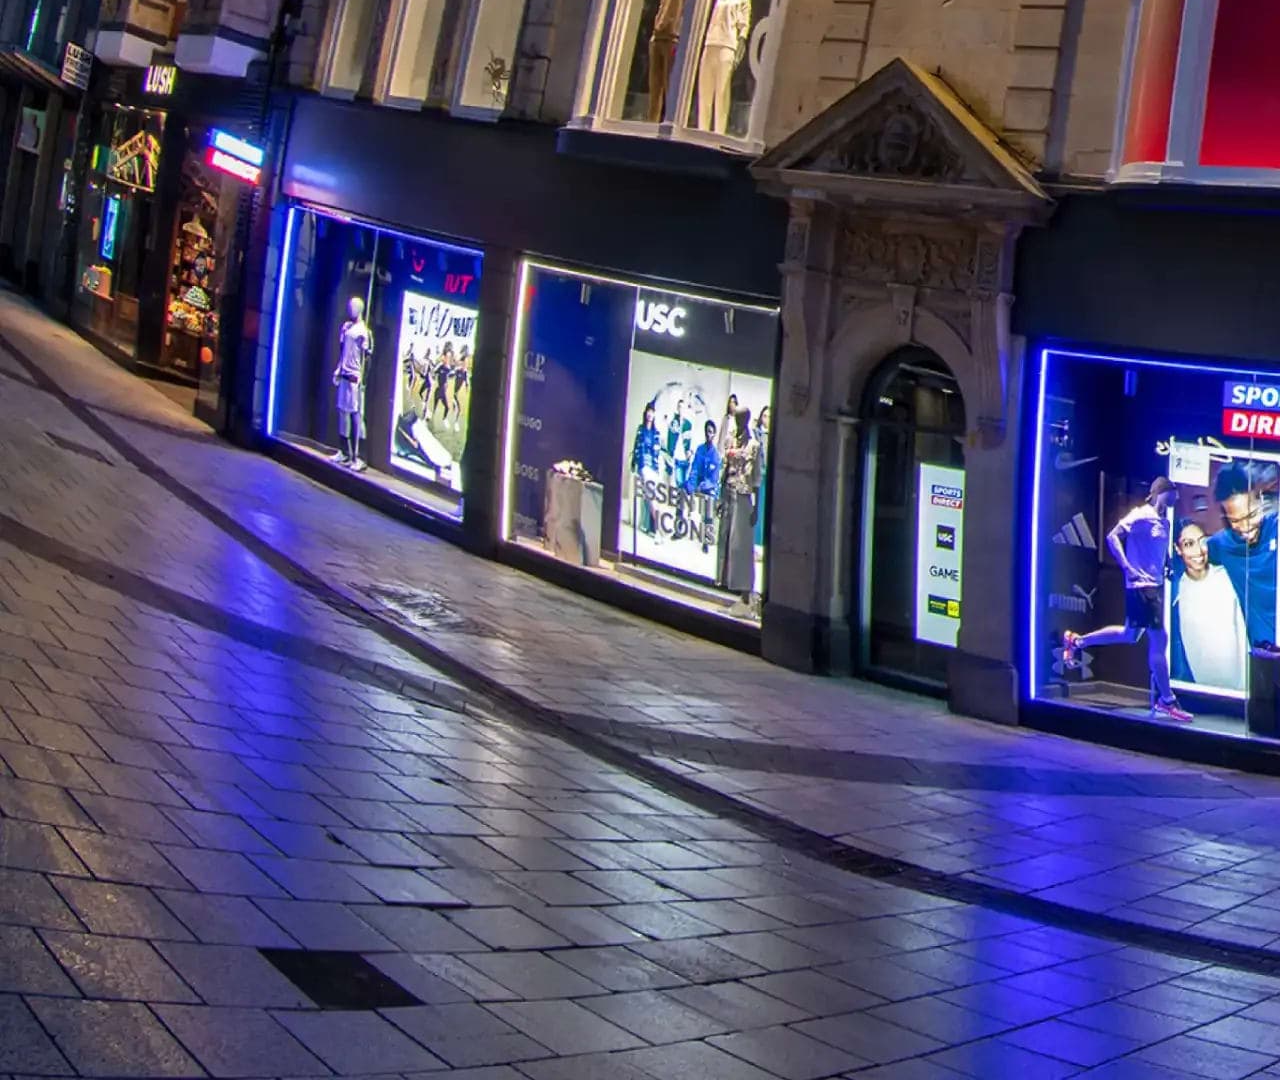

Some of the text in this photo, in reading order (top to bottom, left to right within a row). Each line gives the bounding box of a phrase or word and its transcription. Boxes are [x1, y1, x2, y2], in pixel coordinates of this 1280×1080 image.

[145, 66, 175, 95] LUSH
[634, 299, 688, 337] USC
[933, 485, 962, 498] SPORTS
[933, 496, 962, 509] DIRECT
[654, 510, 715, 546] ICONS
[938, 532, 953, 543] USC
[929, 565, 959, 582] GAME
[1049, 593, 1086, 613] PUMA
